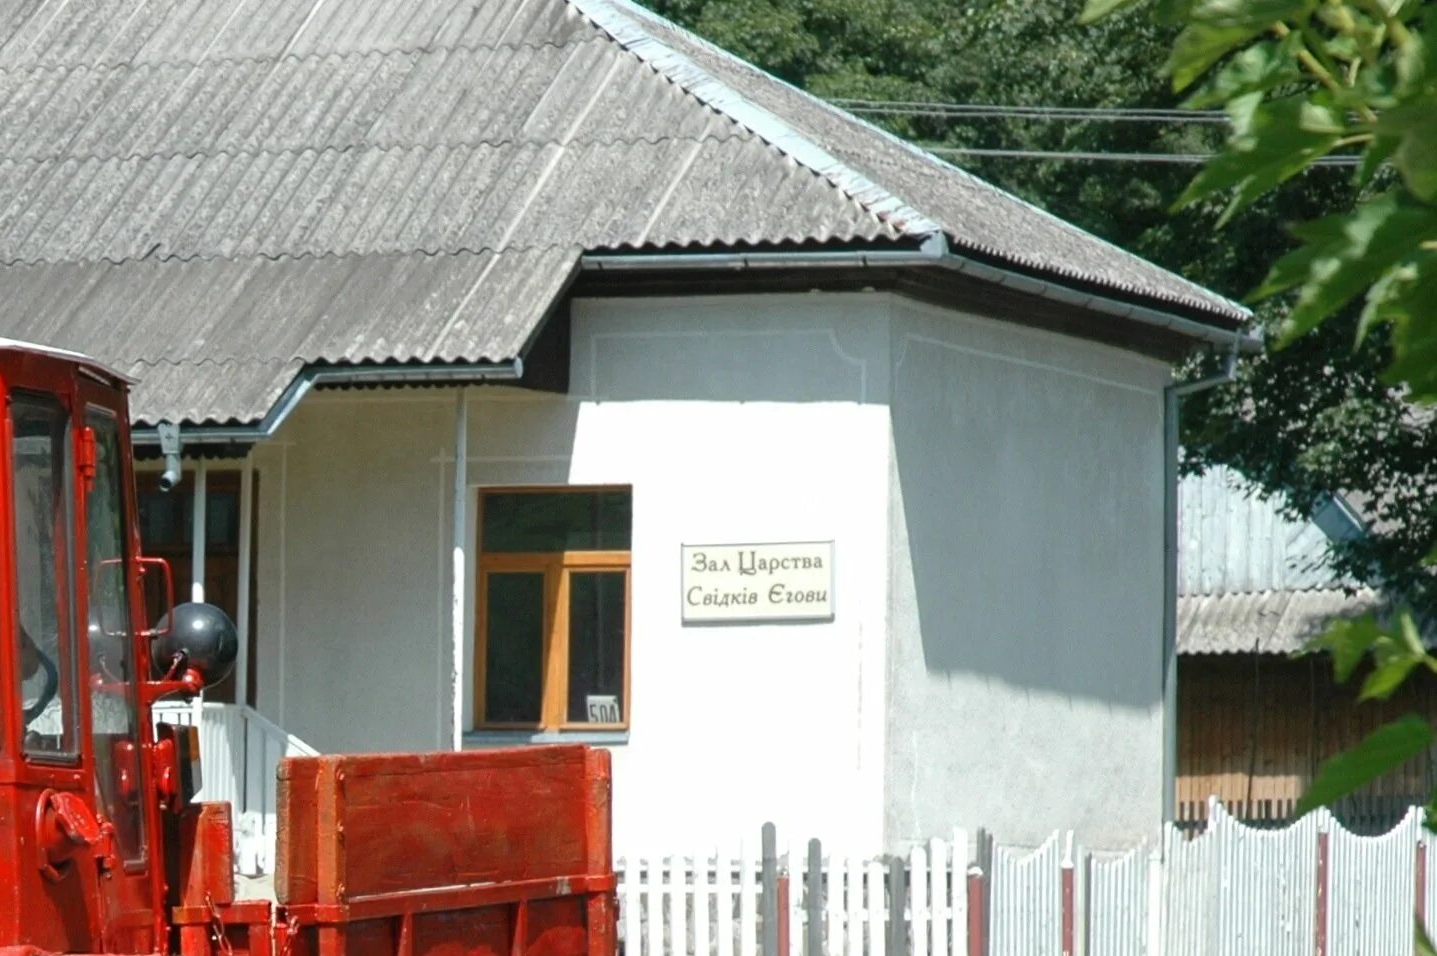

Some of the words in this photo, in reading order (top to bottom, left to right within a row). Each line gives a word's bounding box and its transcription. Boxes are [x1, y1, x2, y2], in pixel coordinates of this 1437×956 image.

[691, 552, 732, 573] Зал
[738, 551, 824, 575] Царства
[686, 586, 759, 608] Свідків
[767, 583, 828, 604] Єгови
